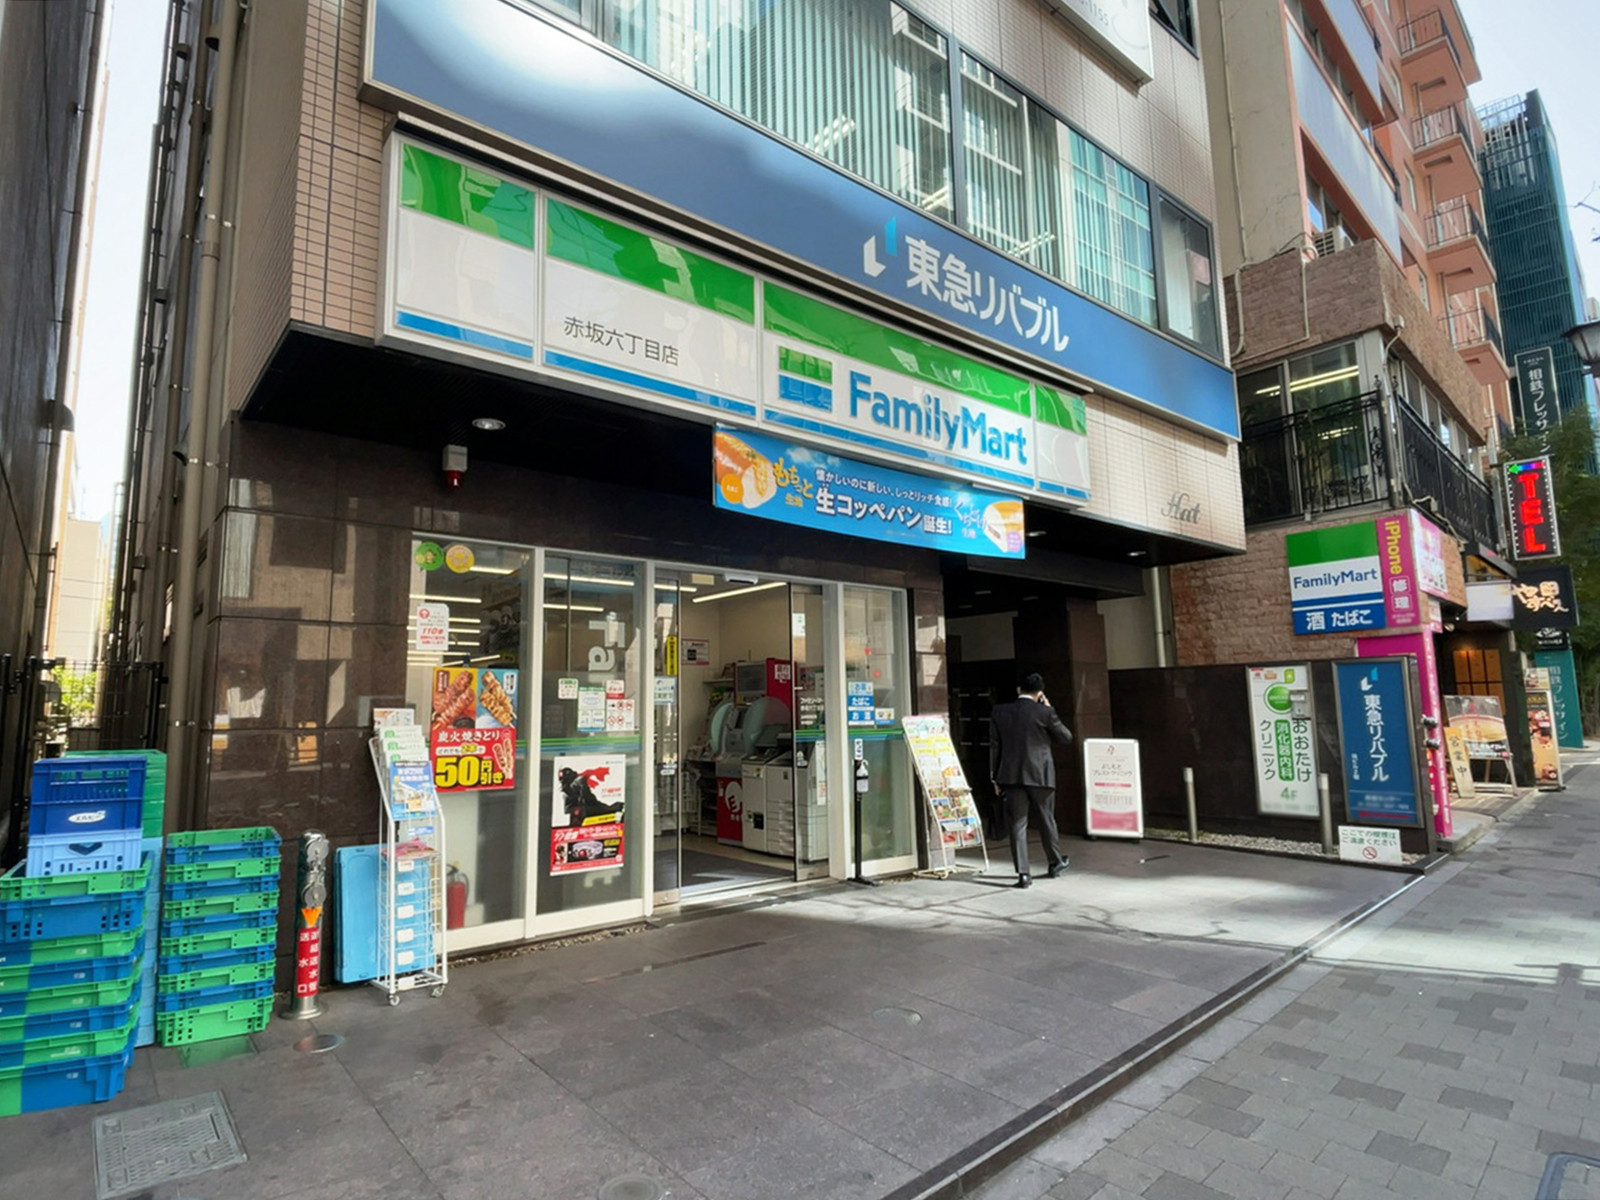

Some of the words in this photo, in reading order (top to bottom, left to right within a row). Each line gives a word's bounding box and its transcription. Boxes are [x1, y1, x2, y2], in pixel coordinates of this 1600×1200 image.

[904, 235, 1070, 352] 東急リバブル
[564, 316, 679, 366] 赤坂六丁目店
[849, 371, 1027, 465] FamilyMart
[1518, 473, 1546, 553] TEL
[1384, 520, 1403, 574] iPhone
[1293, 569, 1378, 589] FamilyMart
[1306, 611, 1326, 631] 酒
[1331, 609, 1373, 627] たばこ
[438, 730, 500, 743] 炭火焼きとり
[1260, 719, 1276, 781] クリニック
[1292, 718, 1313, 783] おおたけ
[1363, 694, 1389, 783] 東急リバブル
[1281, 787, 1298, 801] 4F
